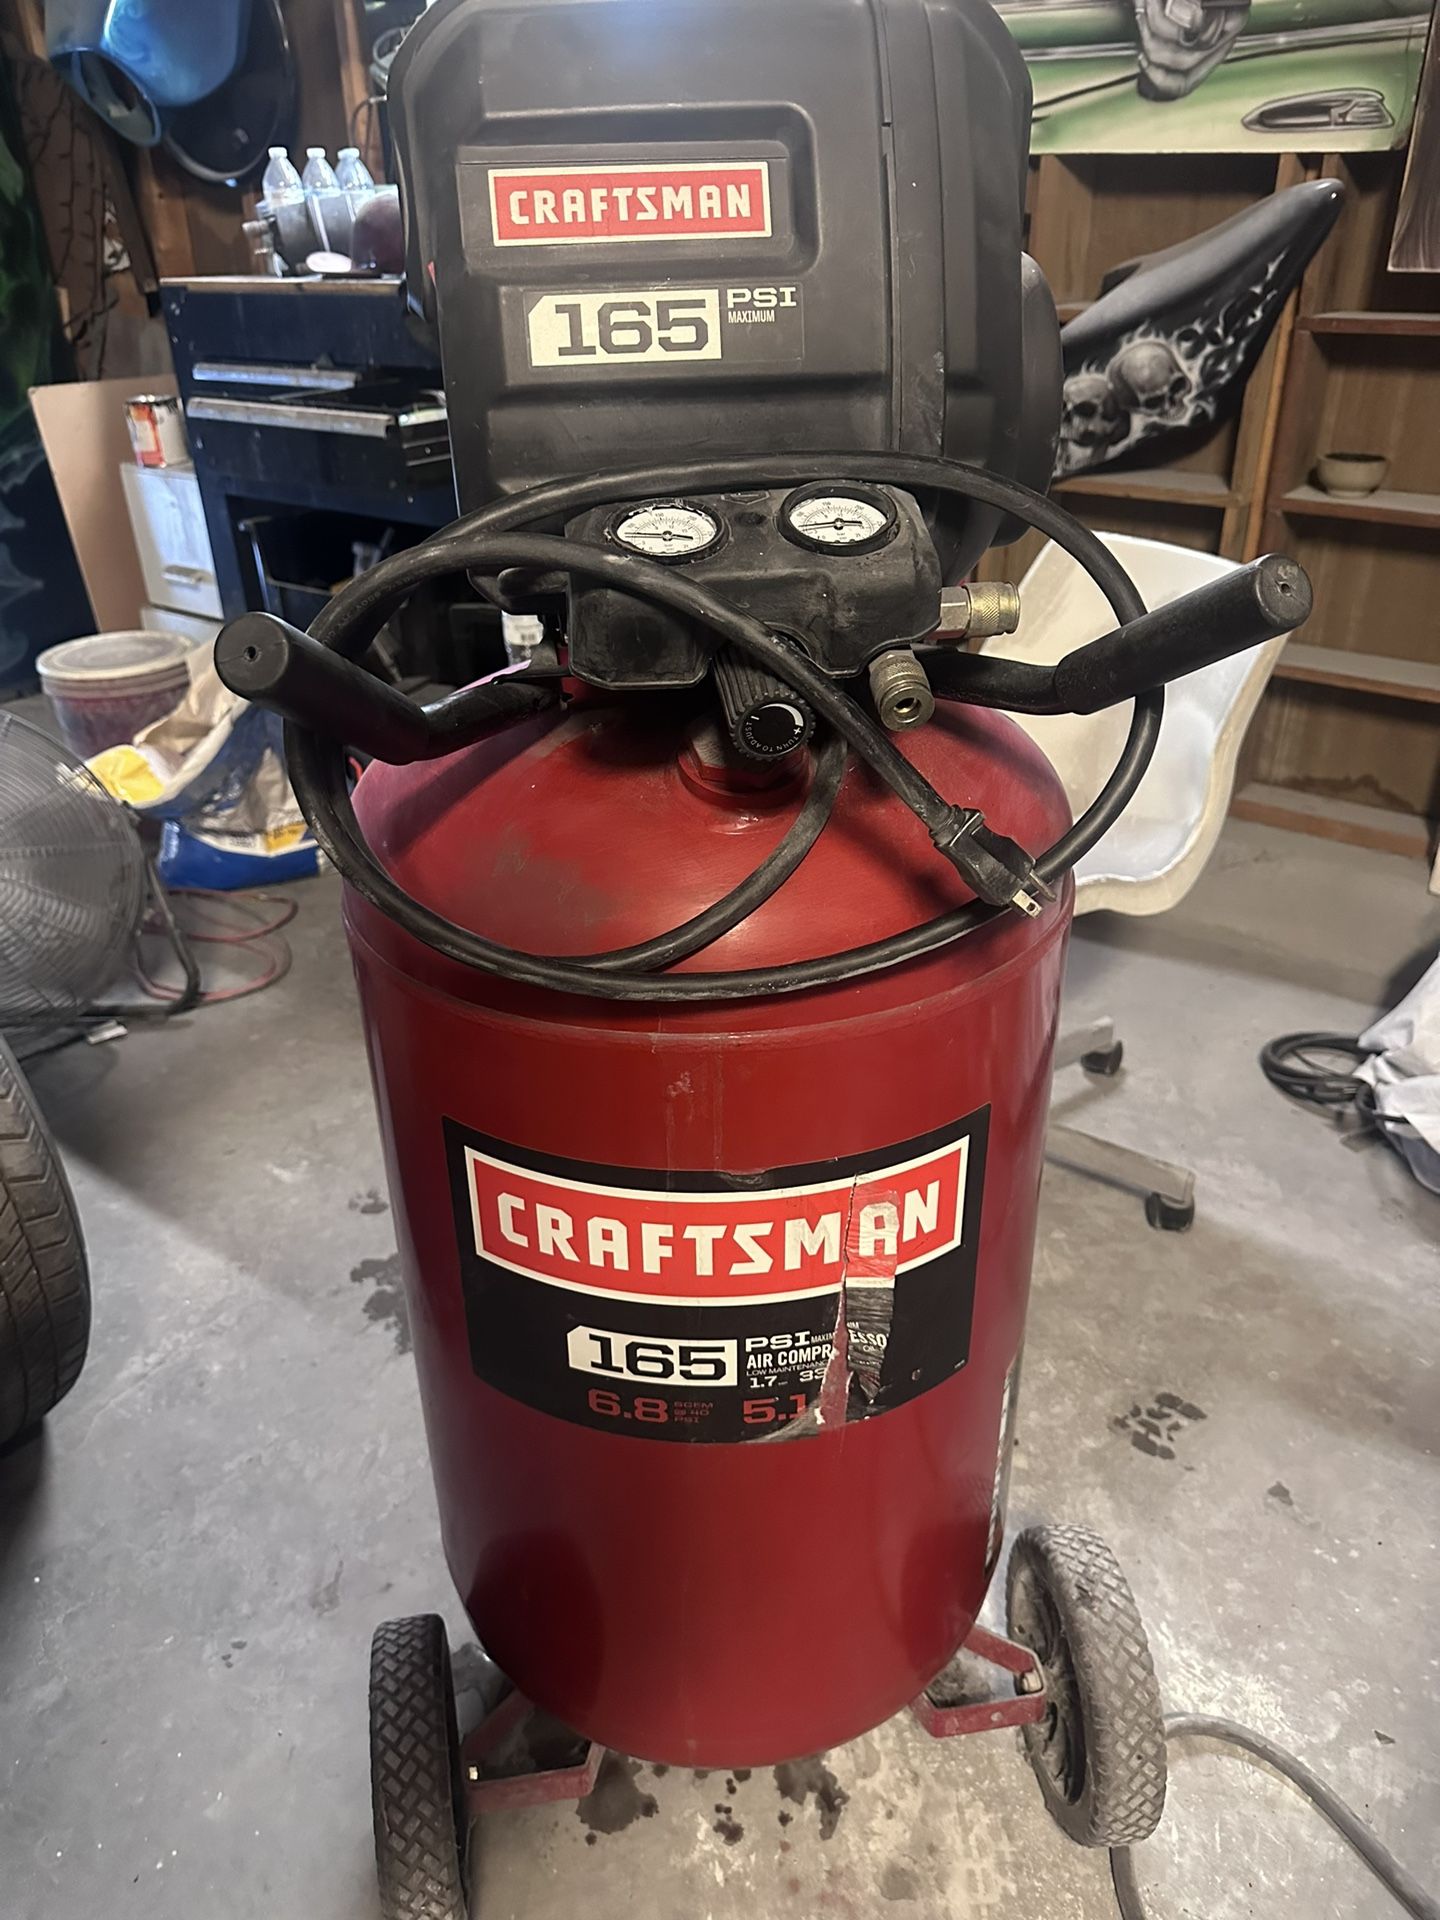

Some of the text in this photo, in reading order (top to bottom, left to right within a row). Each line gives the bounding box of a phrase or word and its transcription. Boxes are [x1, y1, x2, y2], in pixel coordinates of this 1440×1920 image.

[509, 183, 752, 225] CRAFTSMAN
[726, 286, 797, 309] PSI
[554, 298, 709, 357] 165
[727, 310, 775, 323] MAXIMUM
[497, 1180, 940, 1276] CRAFTSMAN
[745, 1330, 811, 1353] PSI
[588, 1333, 727, 1381] 165
[746, 1352, 776, 1370] AIR
[746, 1368, 768, 1377] LOW
[750, 1376, 778, 1389] 1.7
[587, 1388, 669, 1424] 6.8
